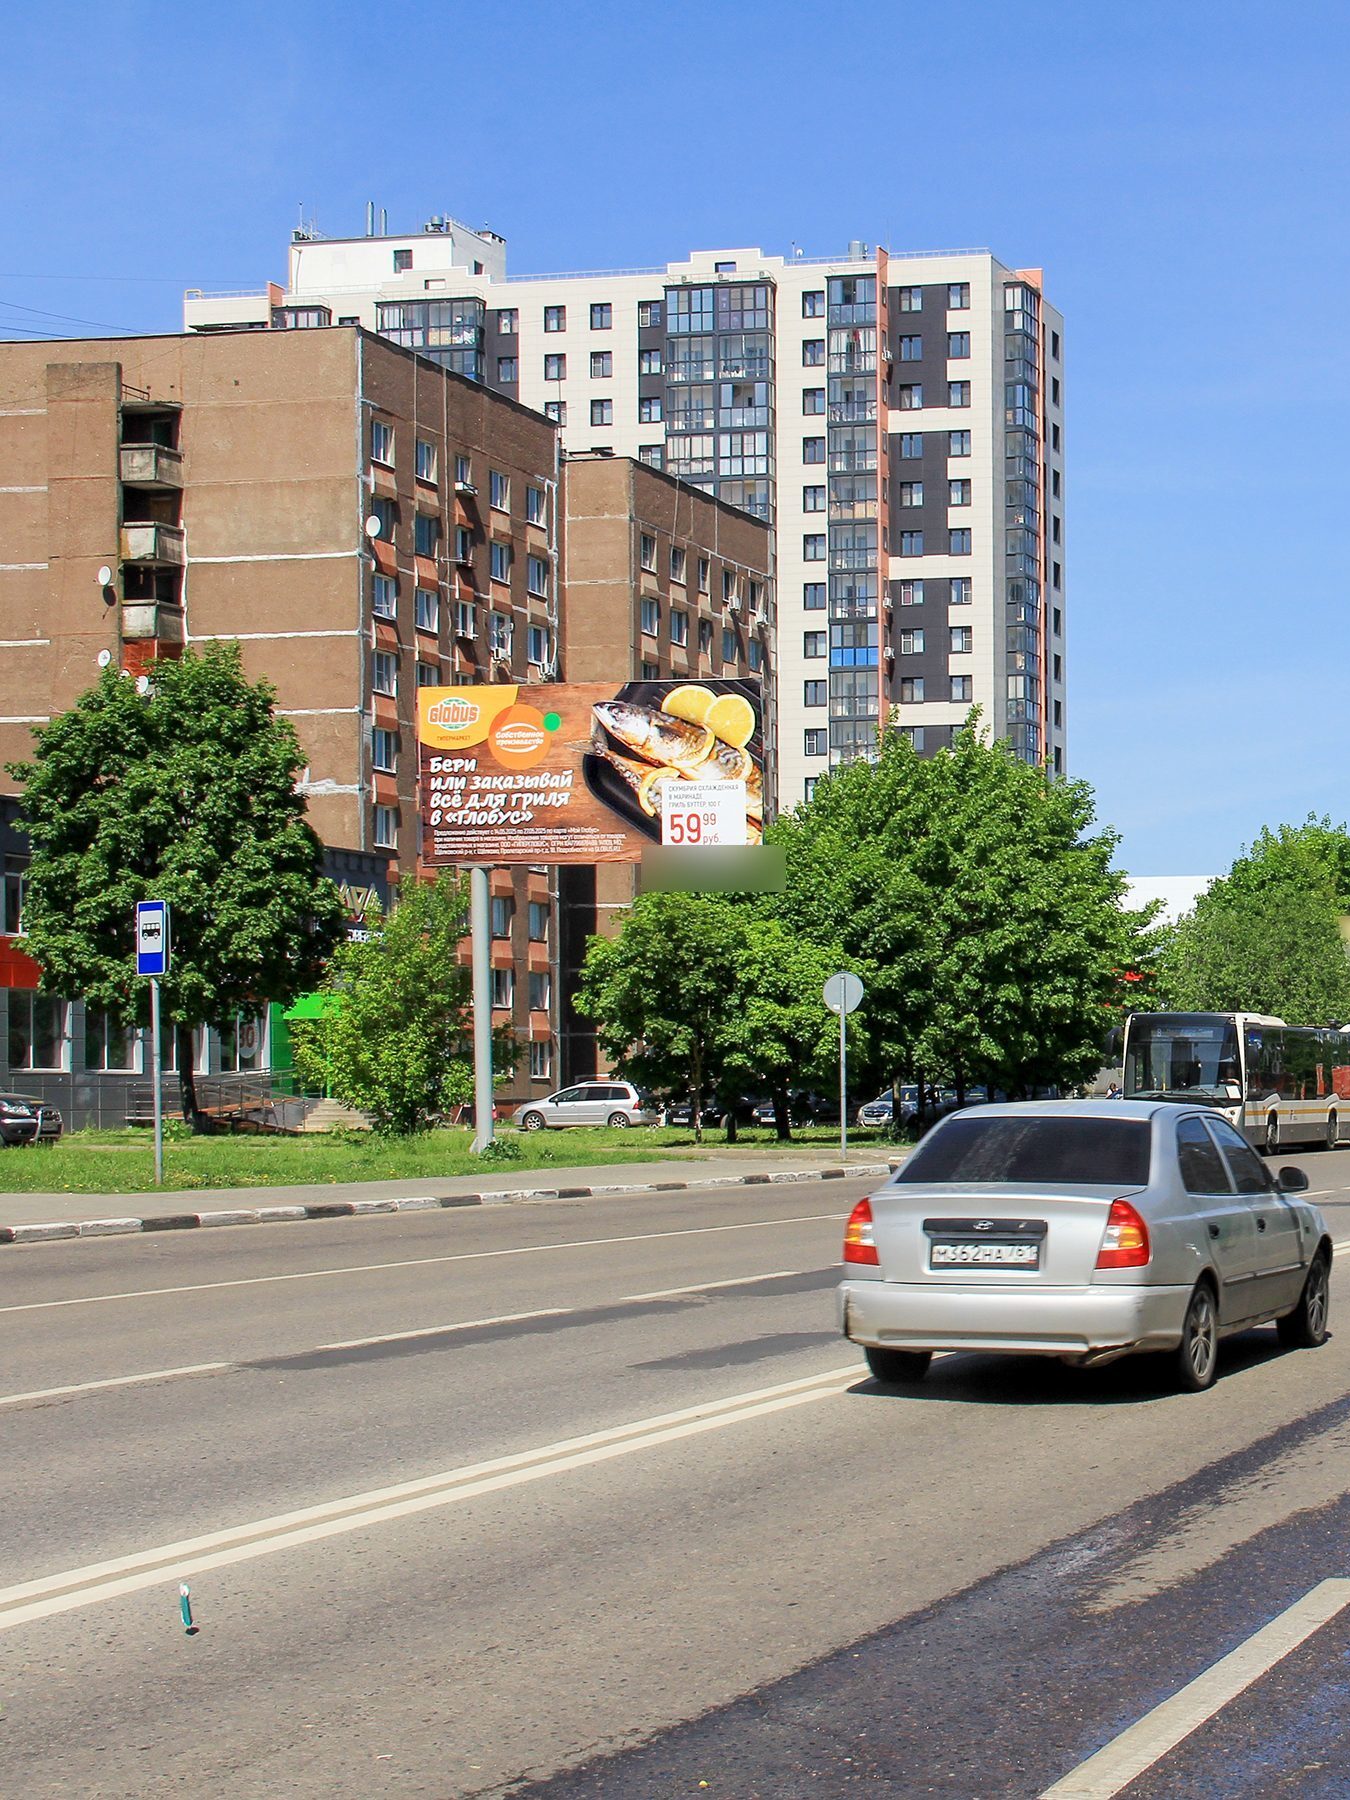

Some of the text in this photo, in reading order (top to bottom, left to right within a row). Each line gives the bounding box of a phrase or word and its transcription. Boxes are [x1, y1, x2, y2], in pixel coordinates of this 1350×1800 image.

[429, 757, 477, 773] Бери
[430, 769, 573, 791] или заказывай
[430, 789, 571, 810] всё для гриля
[430, 807, 534, 826] в «Глобус»
[670, 813, 717, 844] 59 99
[702, 833, 722, 845] руб.
